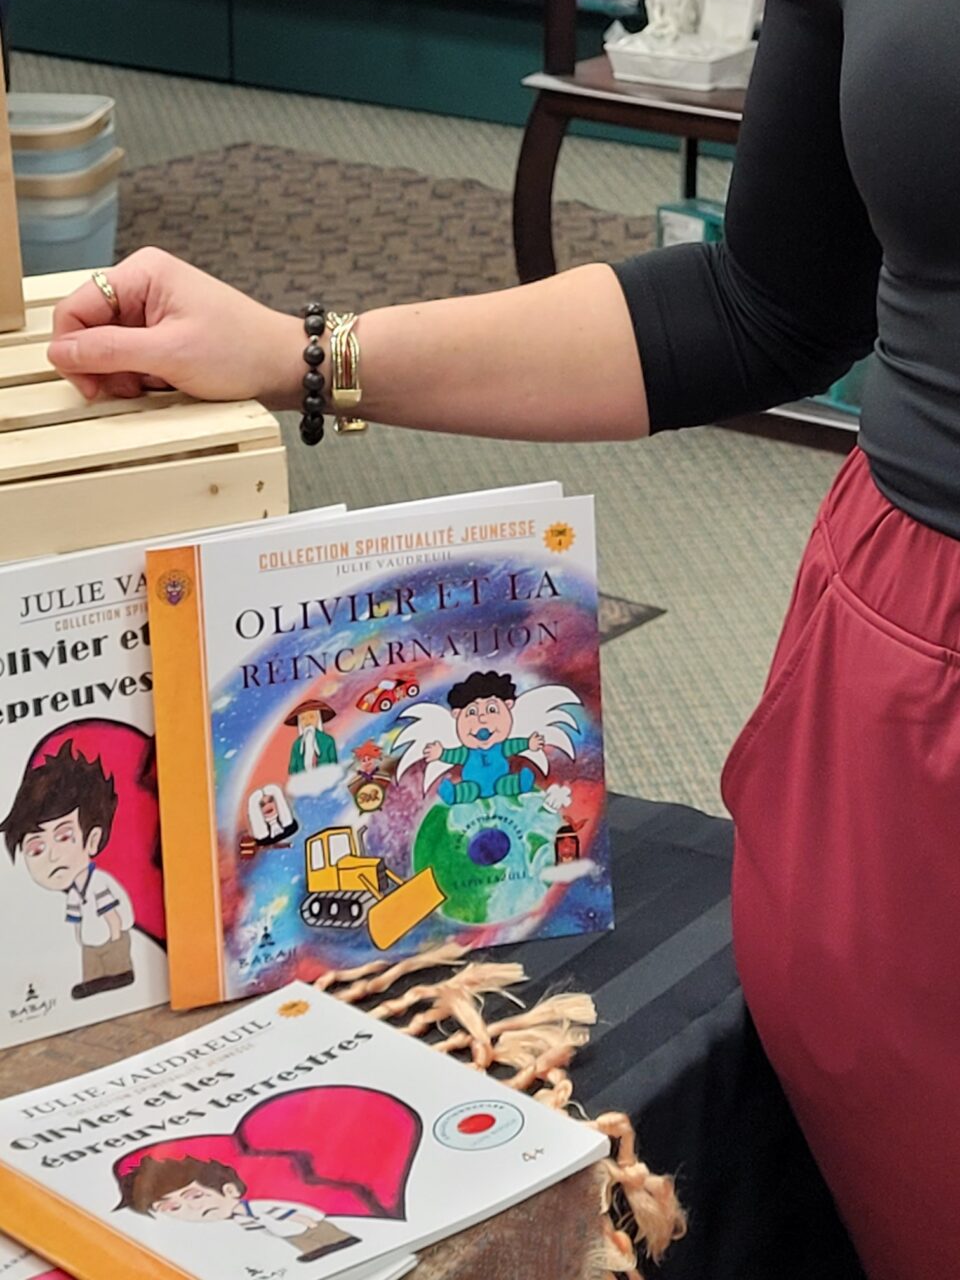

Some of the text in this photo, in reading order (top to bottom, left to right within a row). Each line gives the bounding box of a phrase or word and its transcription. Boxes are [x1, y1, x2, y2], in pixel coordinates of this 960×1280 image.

[258, 519, 536, 571] COLLECTION SPIRITUALITÉ JEUNESSE
[336, 562, 373, 576] JULIE
[19, 580, 106, 618] JULIE
[54, 608, 122, 632] COLLECTION
[235, 569, 561, 641] OLIVIER ET LA
[240, 621, 560, 689] RÉINCARNATION
[20, 1017, 273, 1120] JULIE VAUDREUIL
[39, 1028, 374, 1170] épreuves terrestres
[8, 1067, 237, 1152] Olivier et les
